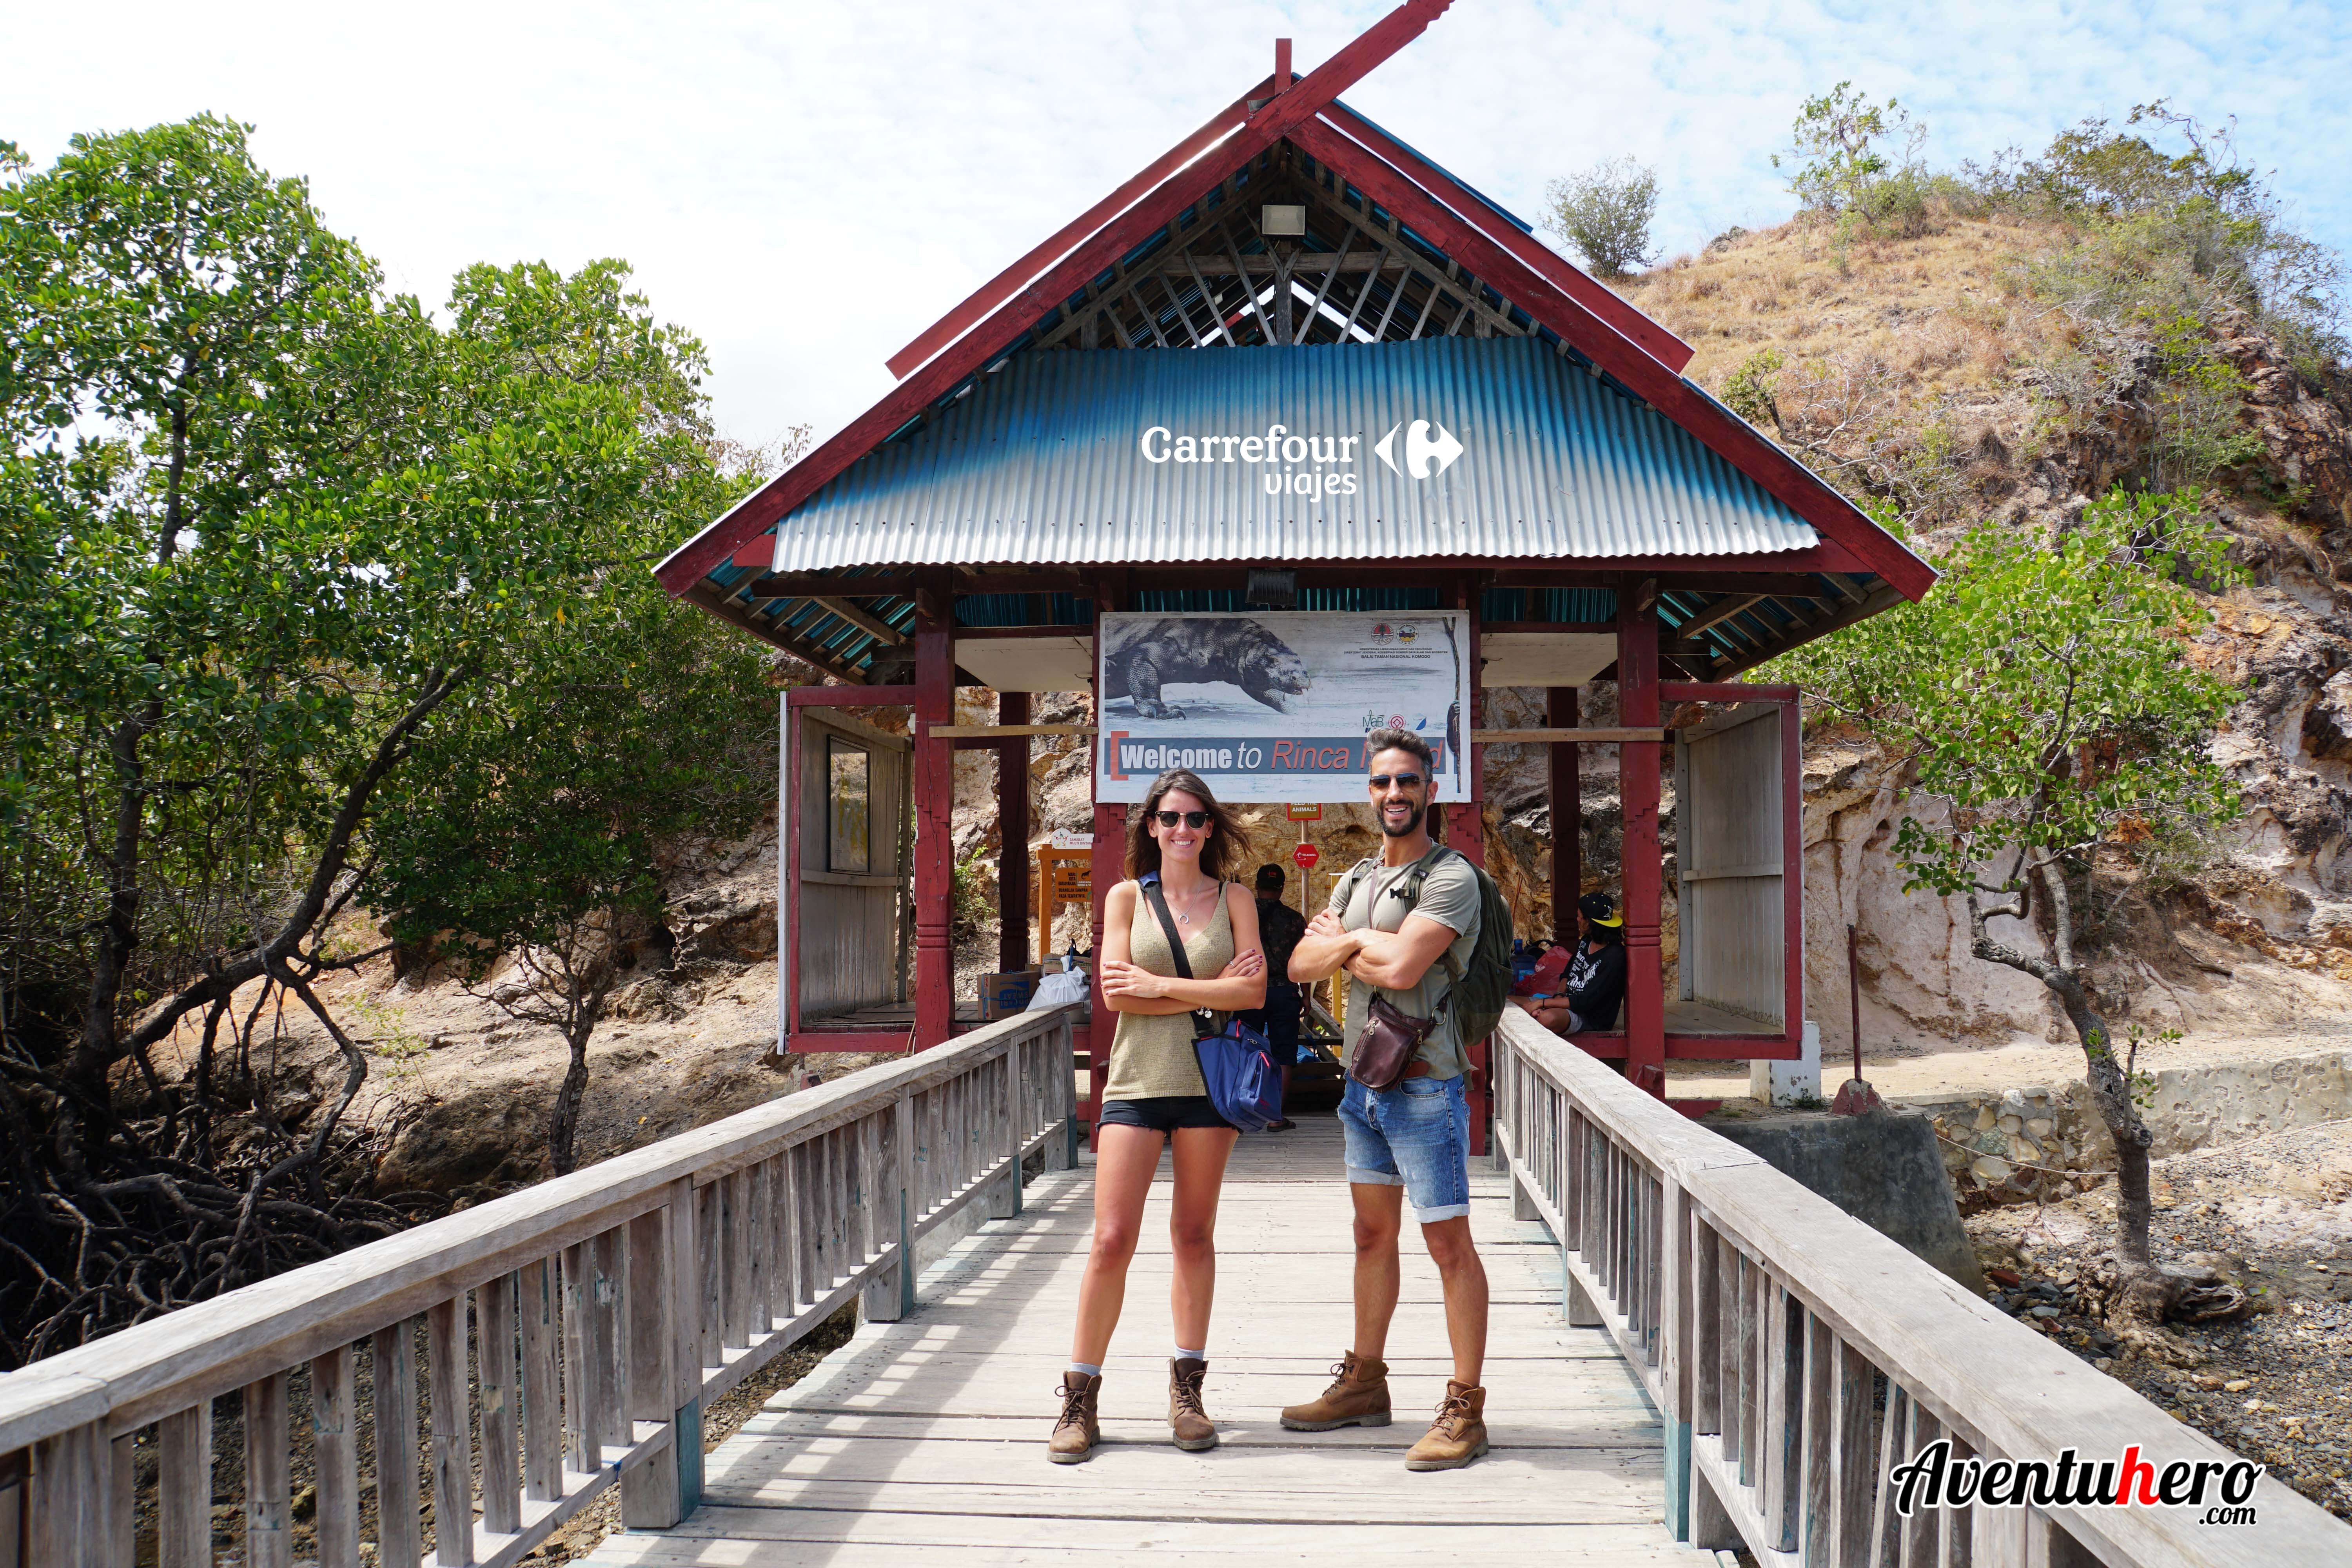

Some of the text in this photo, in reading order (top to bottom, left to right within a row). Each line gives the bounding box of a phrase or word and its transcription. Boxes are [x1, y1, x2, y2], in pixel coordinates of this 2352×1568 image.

[1120, 744, 1232, 769] Welcome
[1237, 741, 1262, 769] to
[1271, 740, 1350, 769] Rinca
